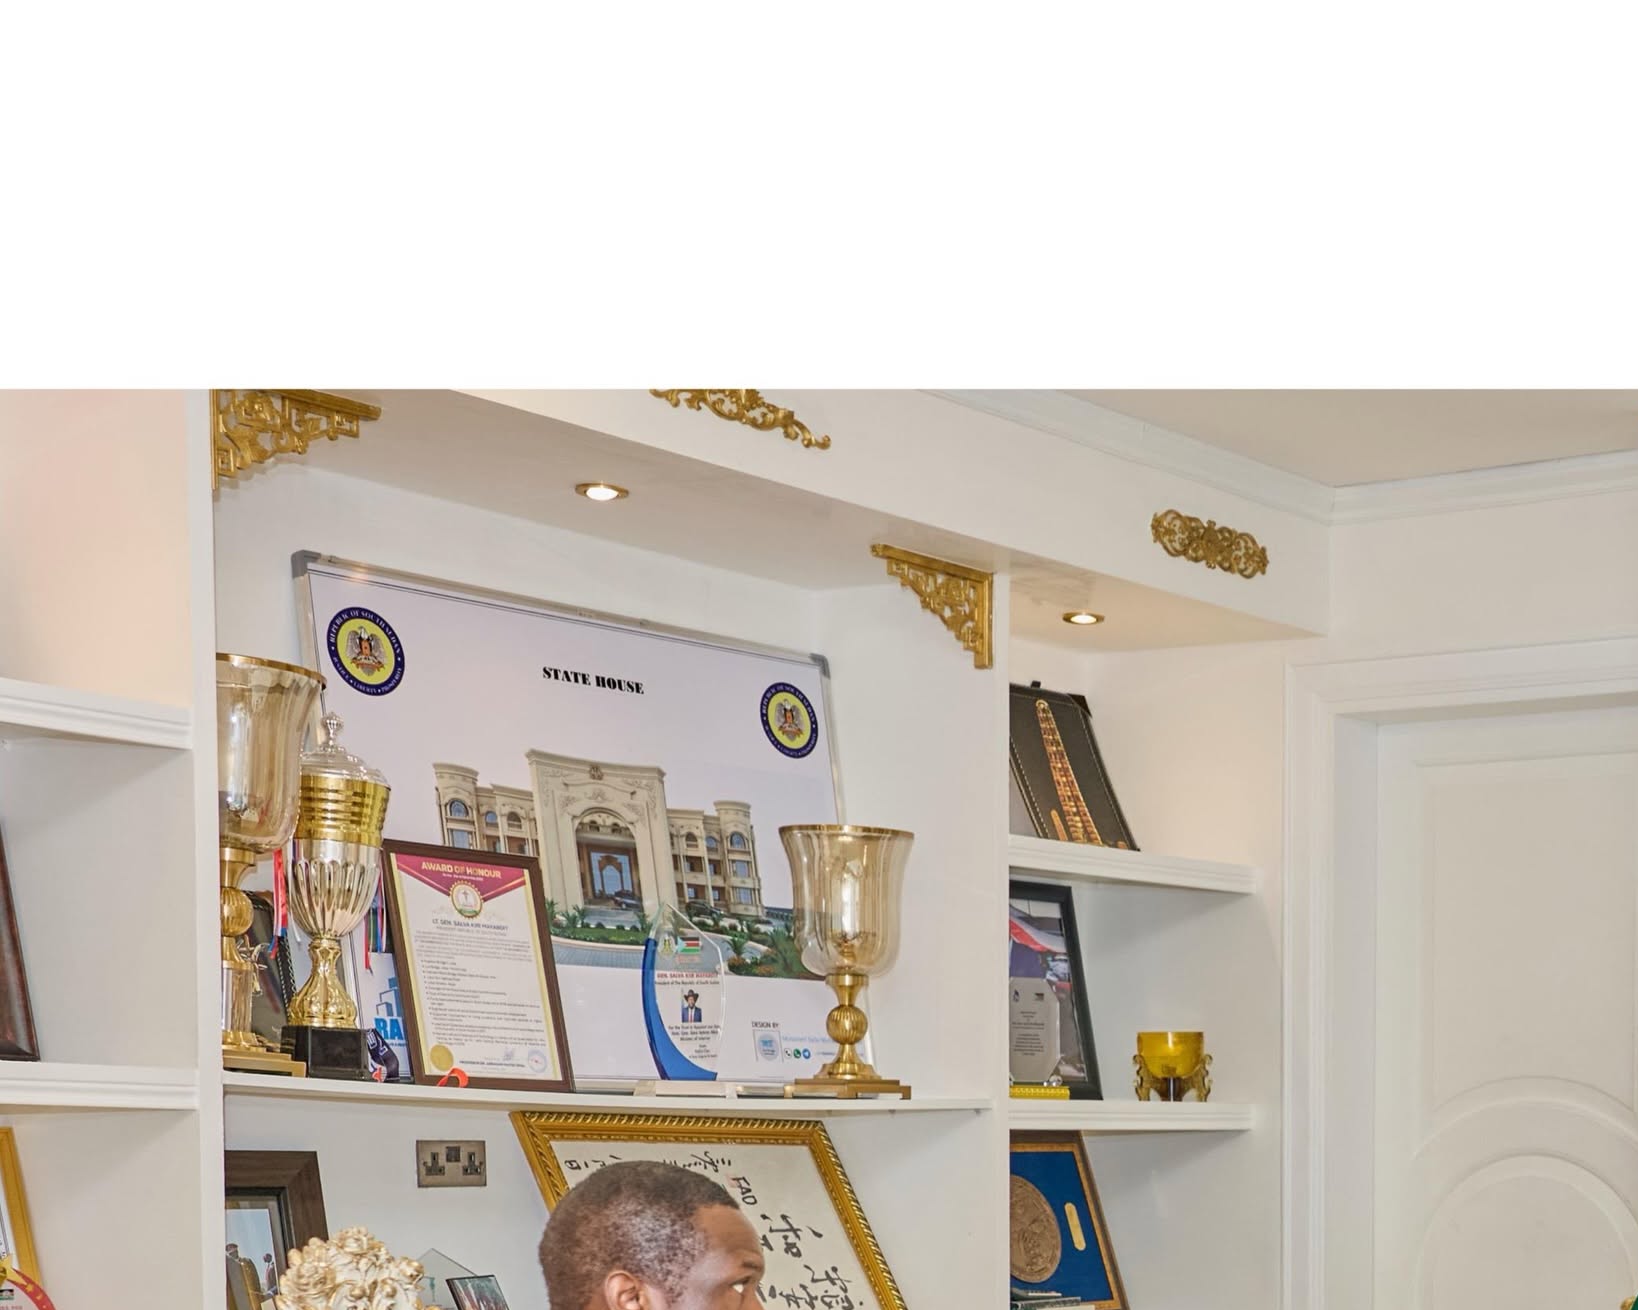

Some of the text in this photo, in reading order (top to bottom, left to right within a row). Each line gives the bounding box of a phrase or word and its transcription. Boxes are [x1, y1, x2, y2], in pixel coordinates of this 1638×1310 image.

[542, 666, 644, 695] STATE HOUSE
[421, 861, 453, 873] AWARD
[454, 865, 465, 874] OF
[466, 866, 502, 879] HONOUR
